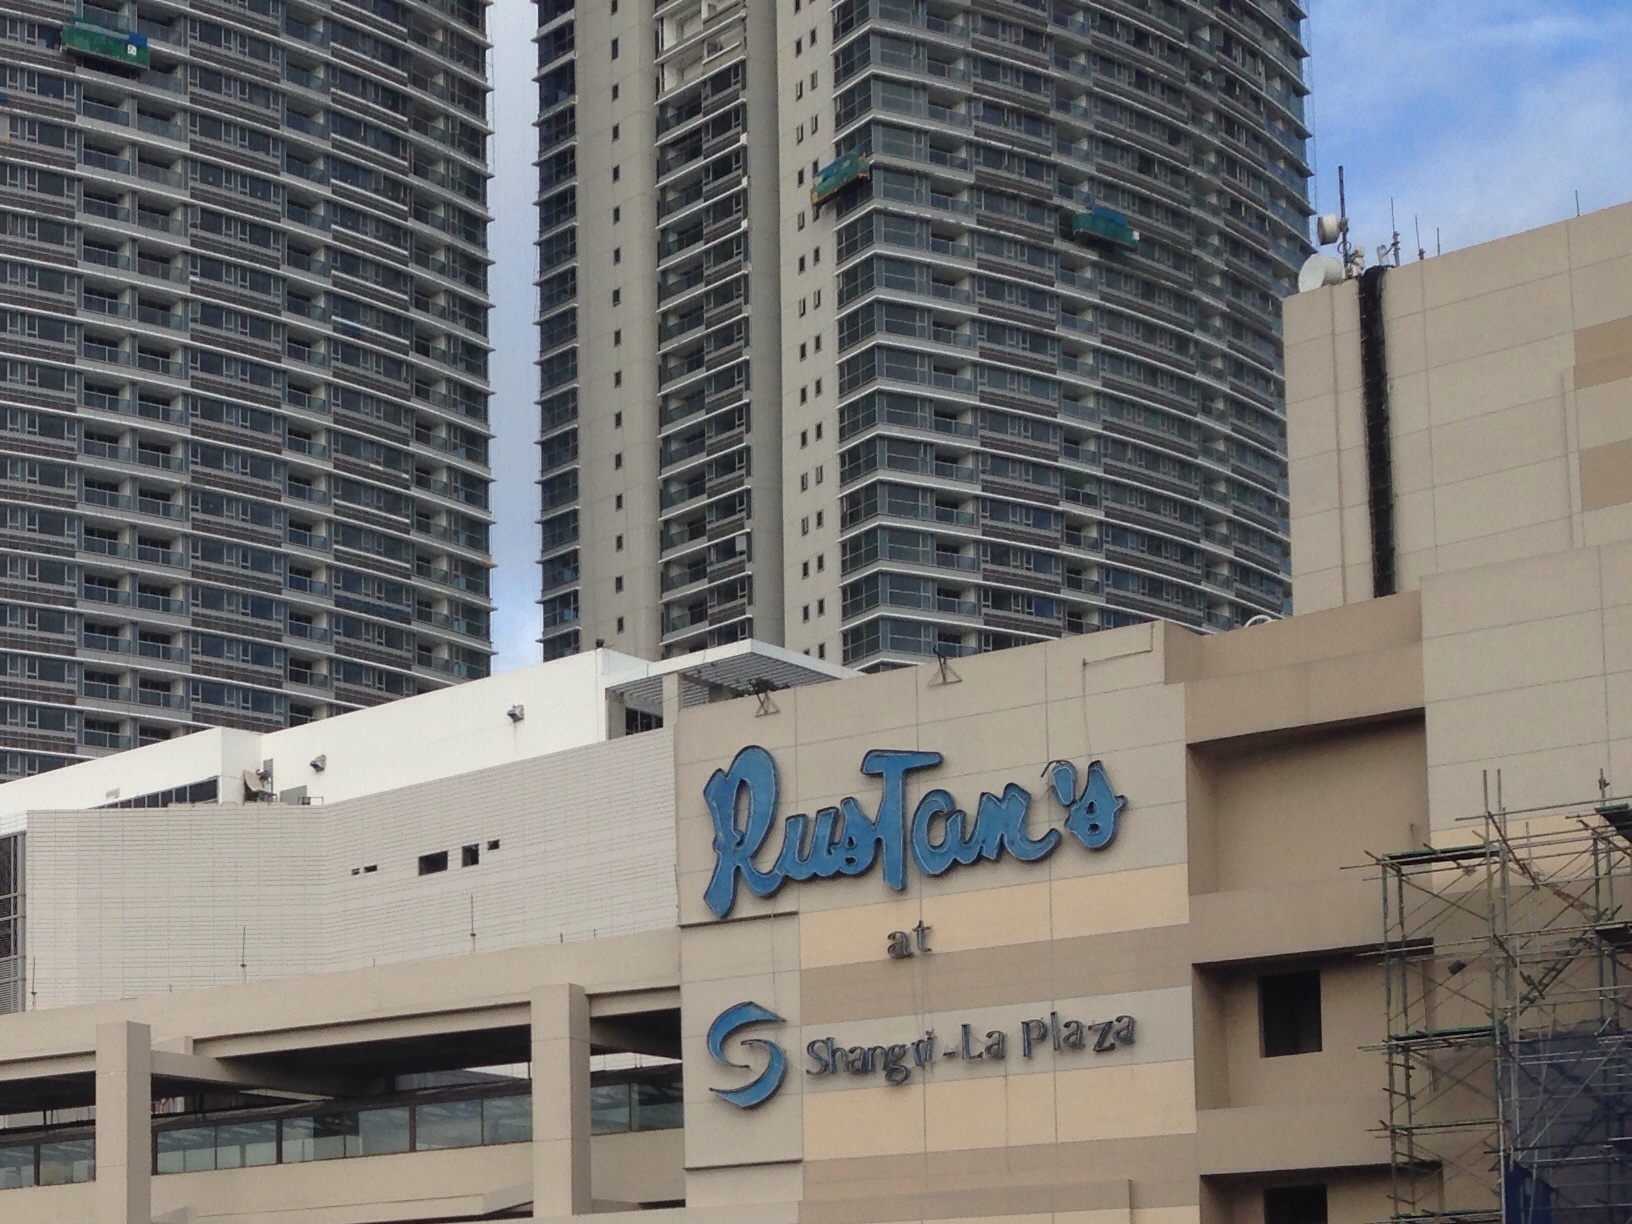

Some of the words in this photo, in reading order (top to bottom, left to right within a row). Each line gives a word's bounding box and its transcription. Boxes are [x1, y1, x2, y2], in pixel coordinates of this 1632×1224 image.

[886, 920, 933, 960] at
[805, 1024, 1007, 1086] Shangri-La
[1021, 1011, 1136, 1060] Plaza
